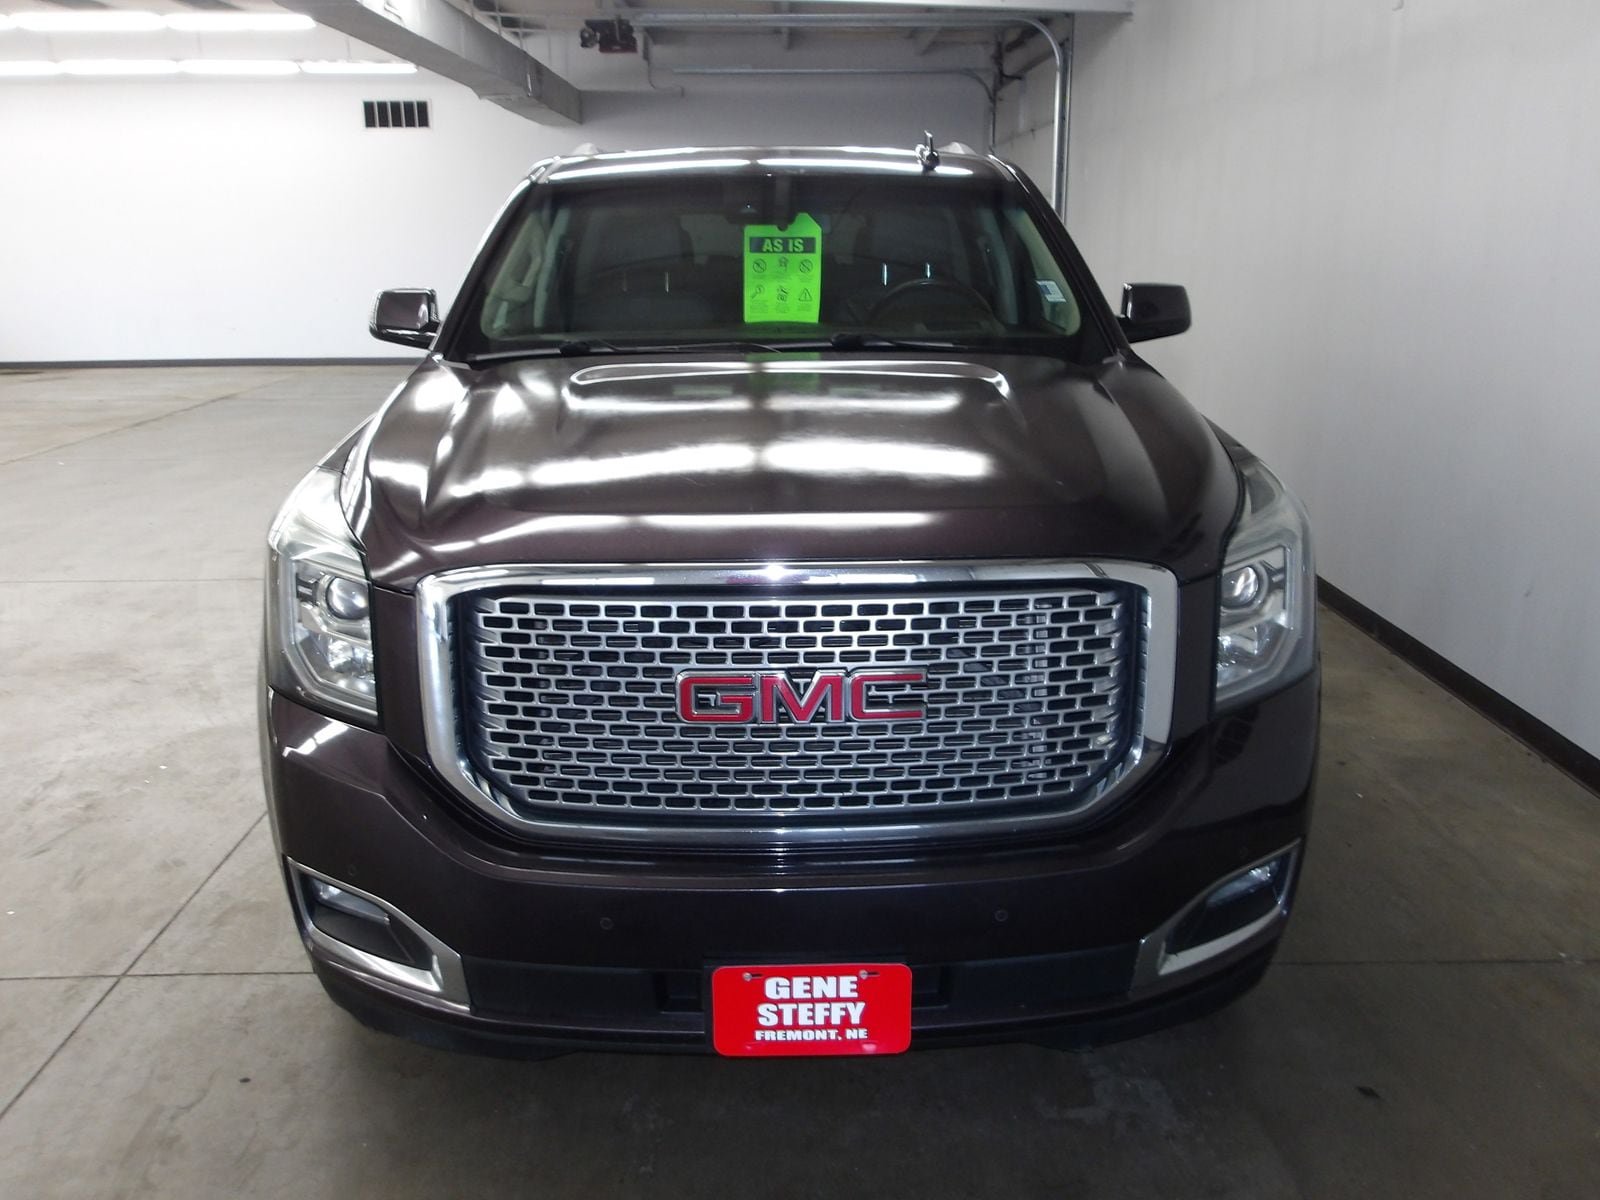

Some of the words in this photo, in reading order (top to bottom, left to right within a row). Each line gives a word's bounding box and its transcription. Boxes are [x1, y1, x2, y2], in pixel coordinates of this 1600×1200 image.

[762, 238, 783, 252] AS
[788, 238, 804, 252] IS
[675, 668, 928, 724] GMC
[764, 975, 859, 1000] GENE
[756, 1001, 866, 1027] STEFFY
[845, 1028, 869, 1040] NE
